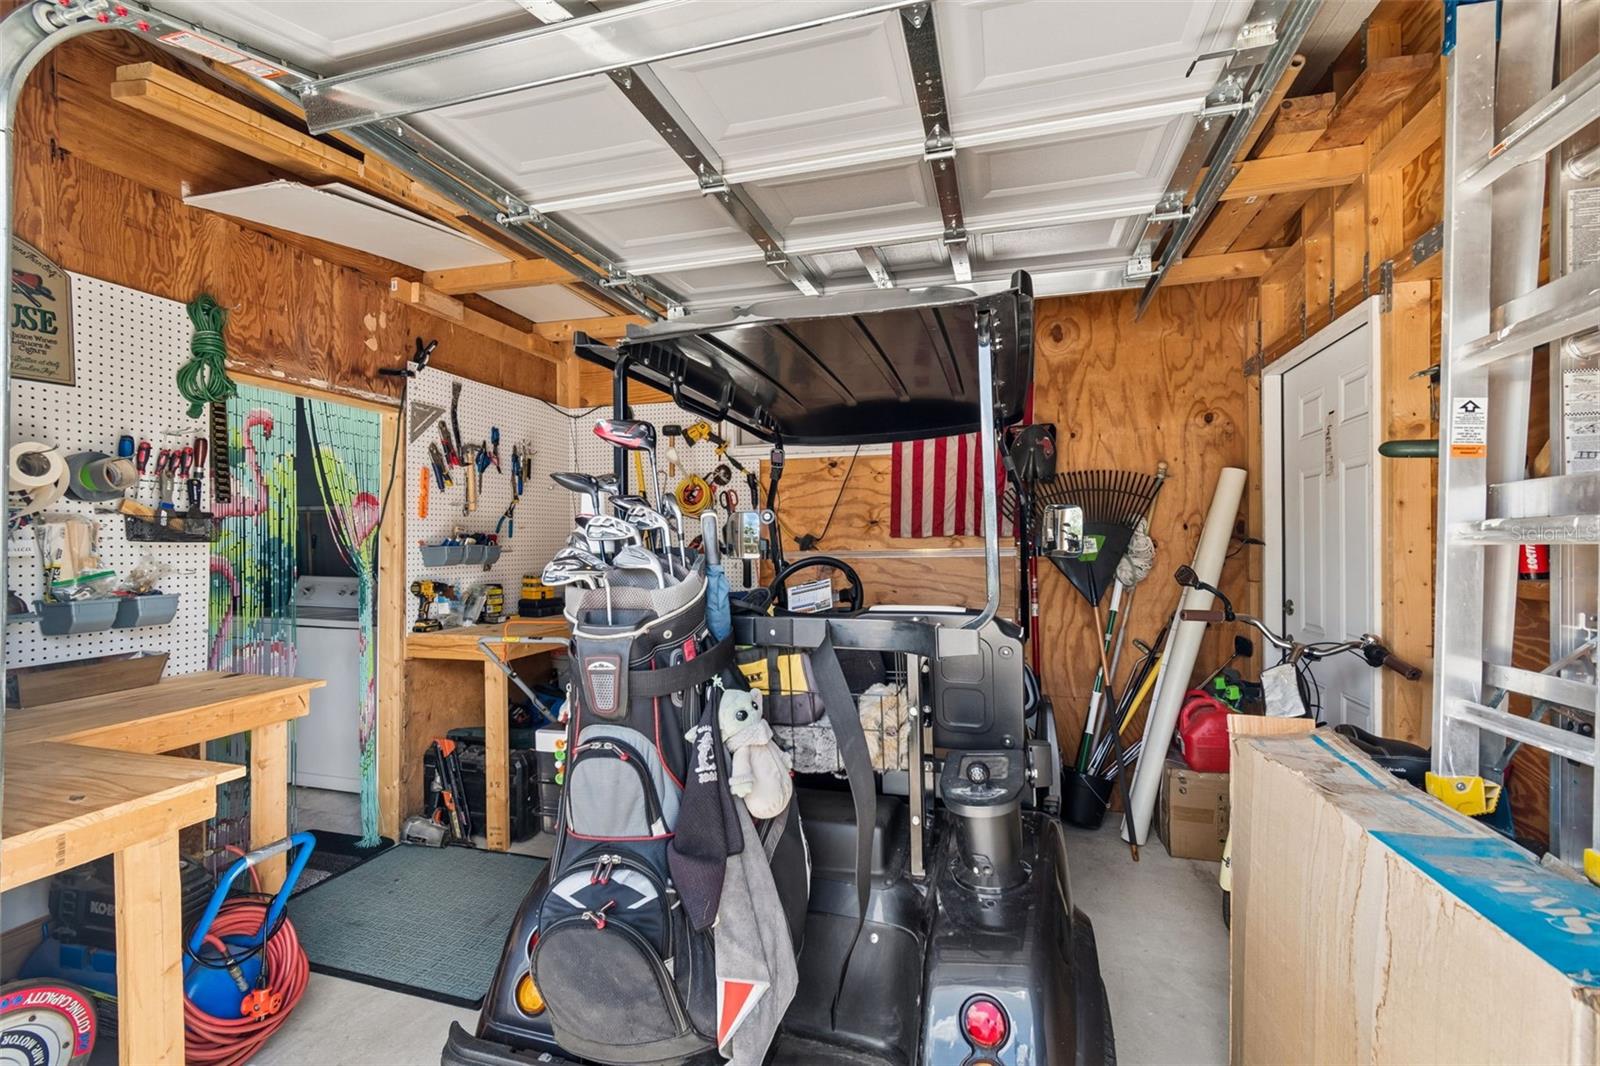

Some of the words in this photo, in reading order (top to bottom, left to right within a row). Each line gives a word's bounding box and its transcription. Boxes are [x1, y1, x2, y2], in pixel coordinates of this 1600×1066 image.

[90, 900, 115, 917] KOB
[23, 991, 72, 1008] CAPACITY
[65, 1000, 92, 1034] CUTTING
